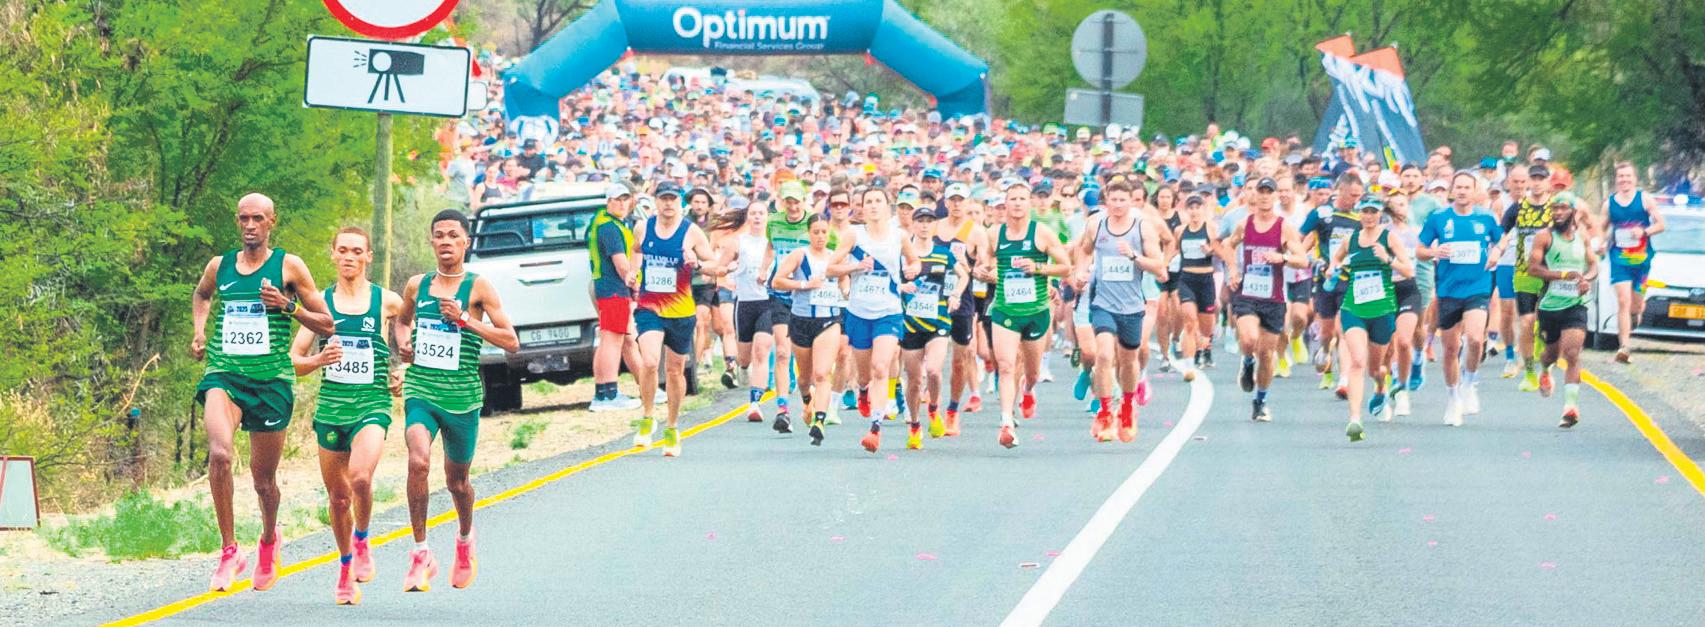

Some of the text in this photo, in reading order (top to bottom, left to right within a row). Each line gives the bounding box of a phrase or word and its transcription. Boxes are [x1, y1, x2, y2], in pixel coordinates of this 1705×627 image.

[672, 6, 829, 48] Optimum
[714, 42, 824, 51] Financial Services Group
[651, 276, 673, 286] 3286
[230, 331, 264, 345] 2362
[421, 342, 454, 359] 3524
[334, 360, 369, 374] 3485
